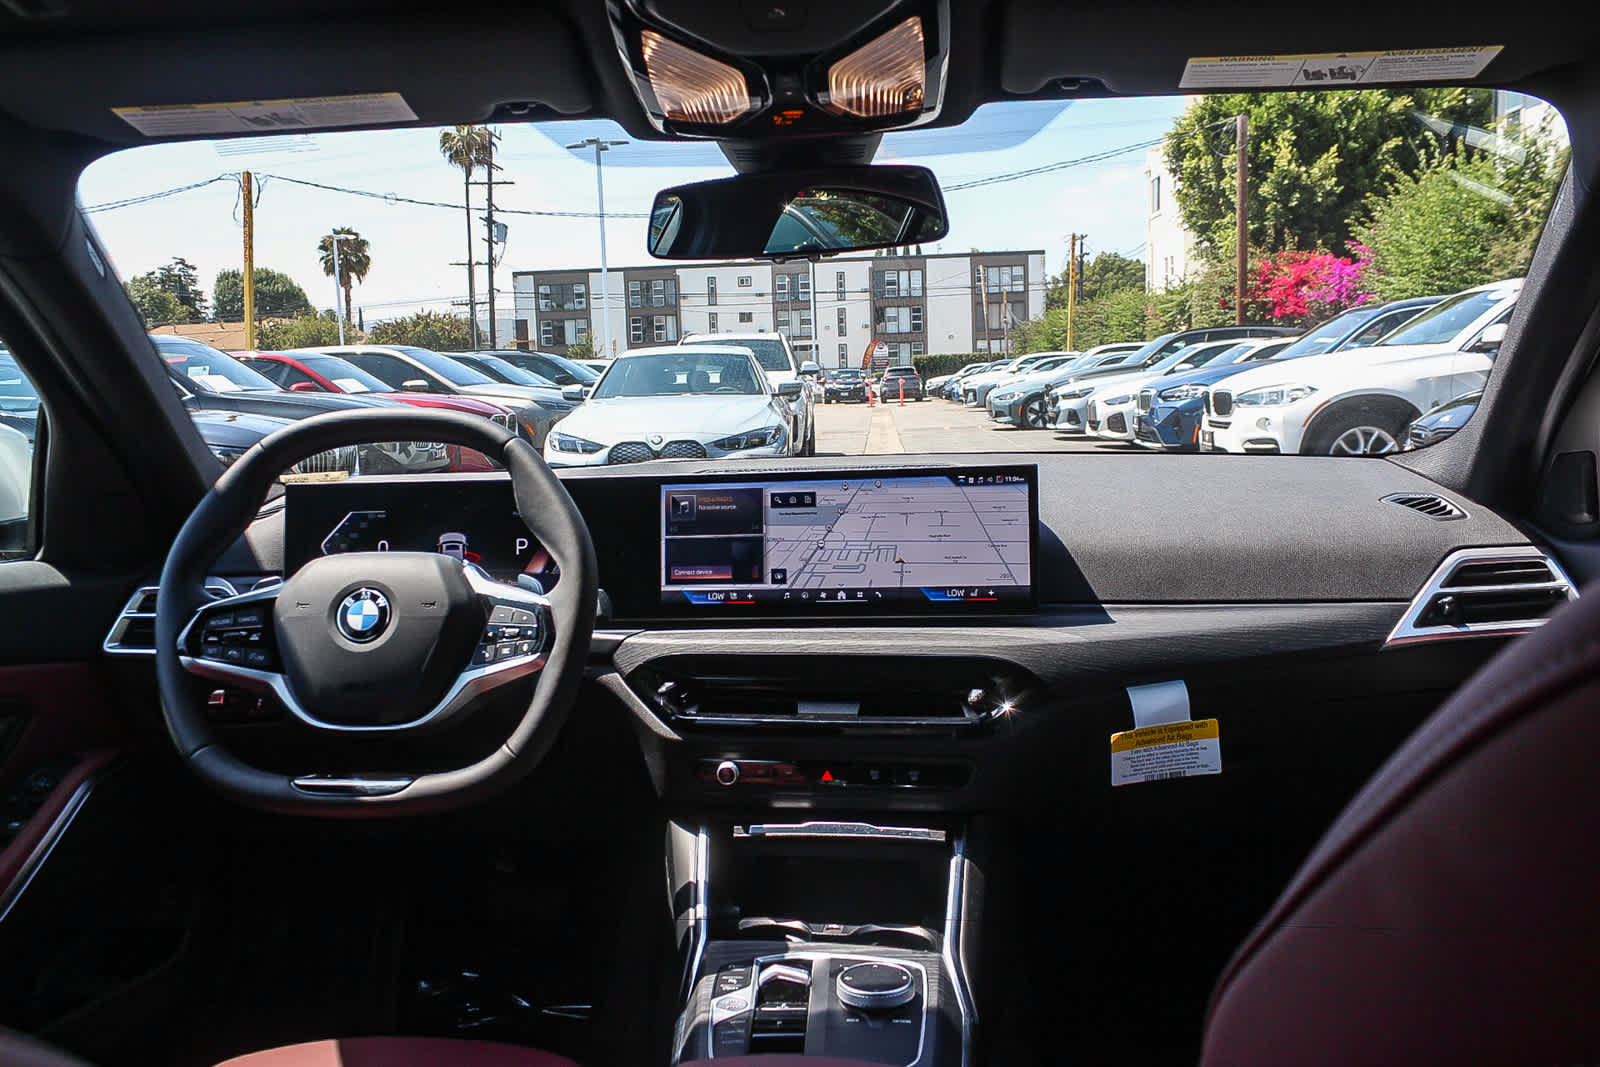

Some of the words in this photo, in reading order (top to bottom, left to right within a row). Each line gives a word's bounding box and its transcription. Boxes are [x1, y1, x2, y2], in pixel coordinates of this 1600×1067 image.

[516, 538, 528, 555] P
[707, 592, 726, 600] LOW
[946, 588, 965, 597] LOW
[344, 591, 386, 607] BMW
[1194, 720, 1209, 729] with
[1176, 733, 1193, 743] Bags
